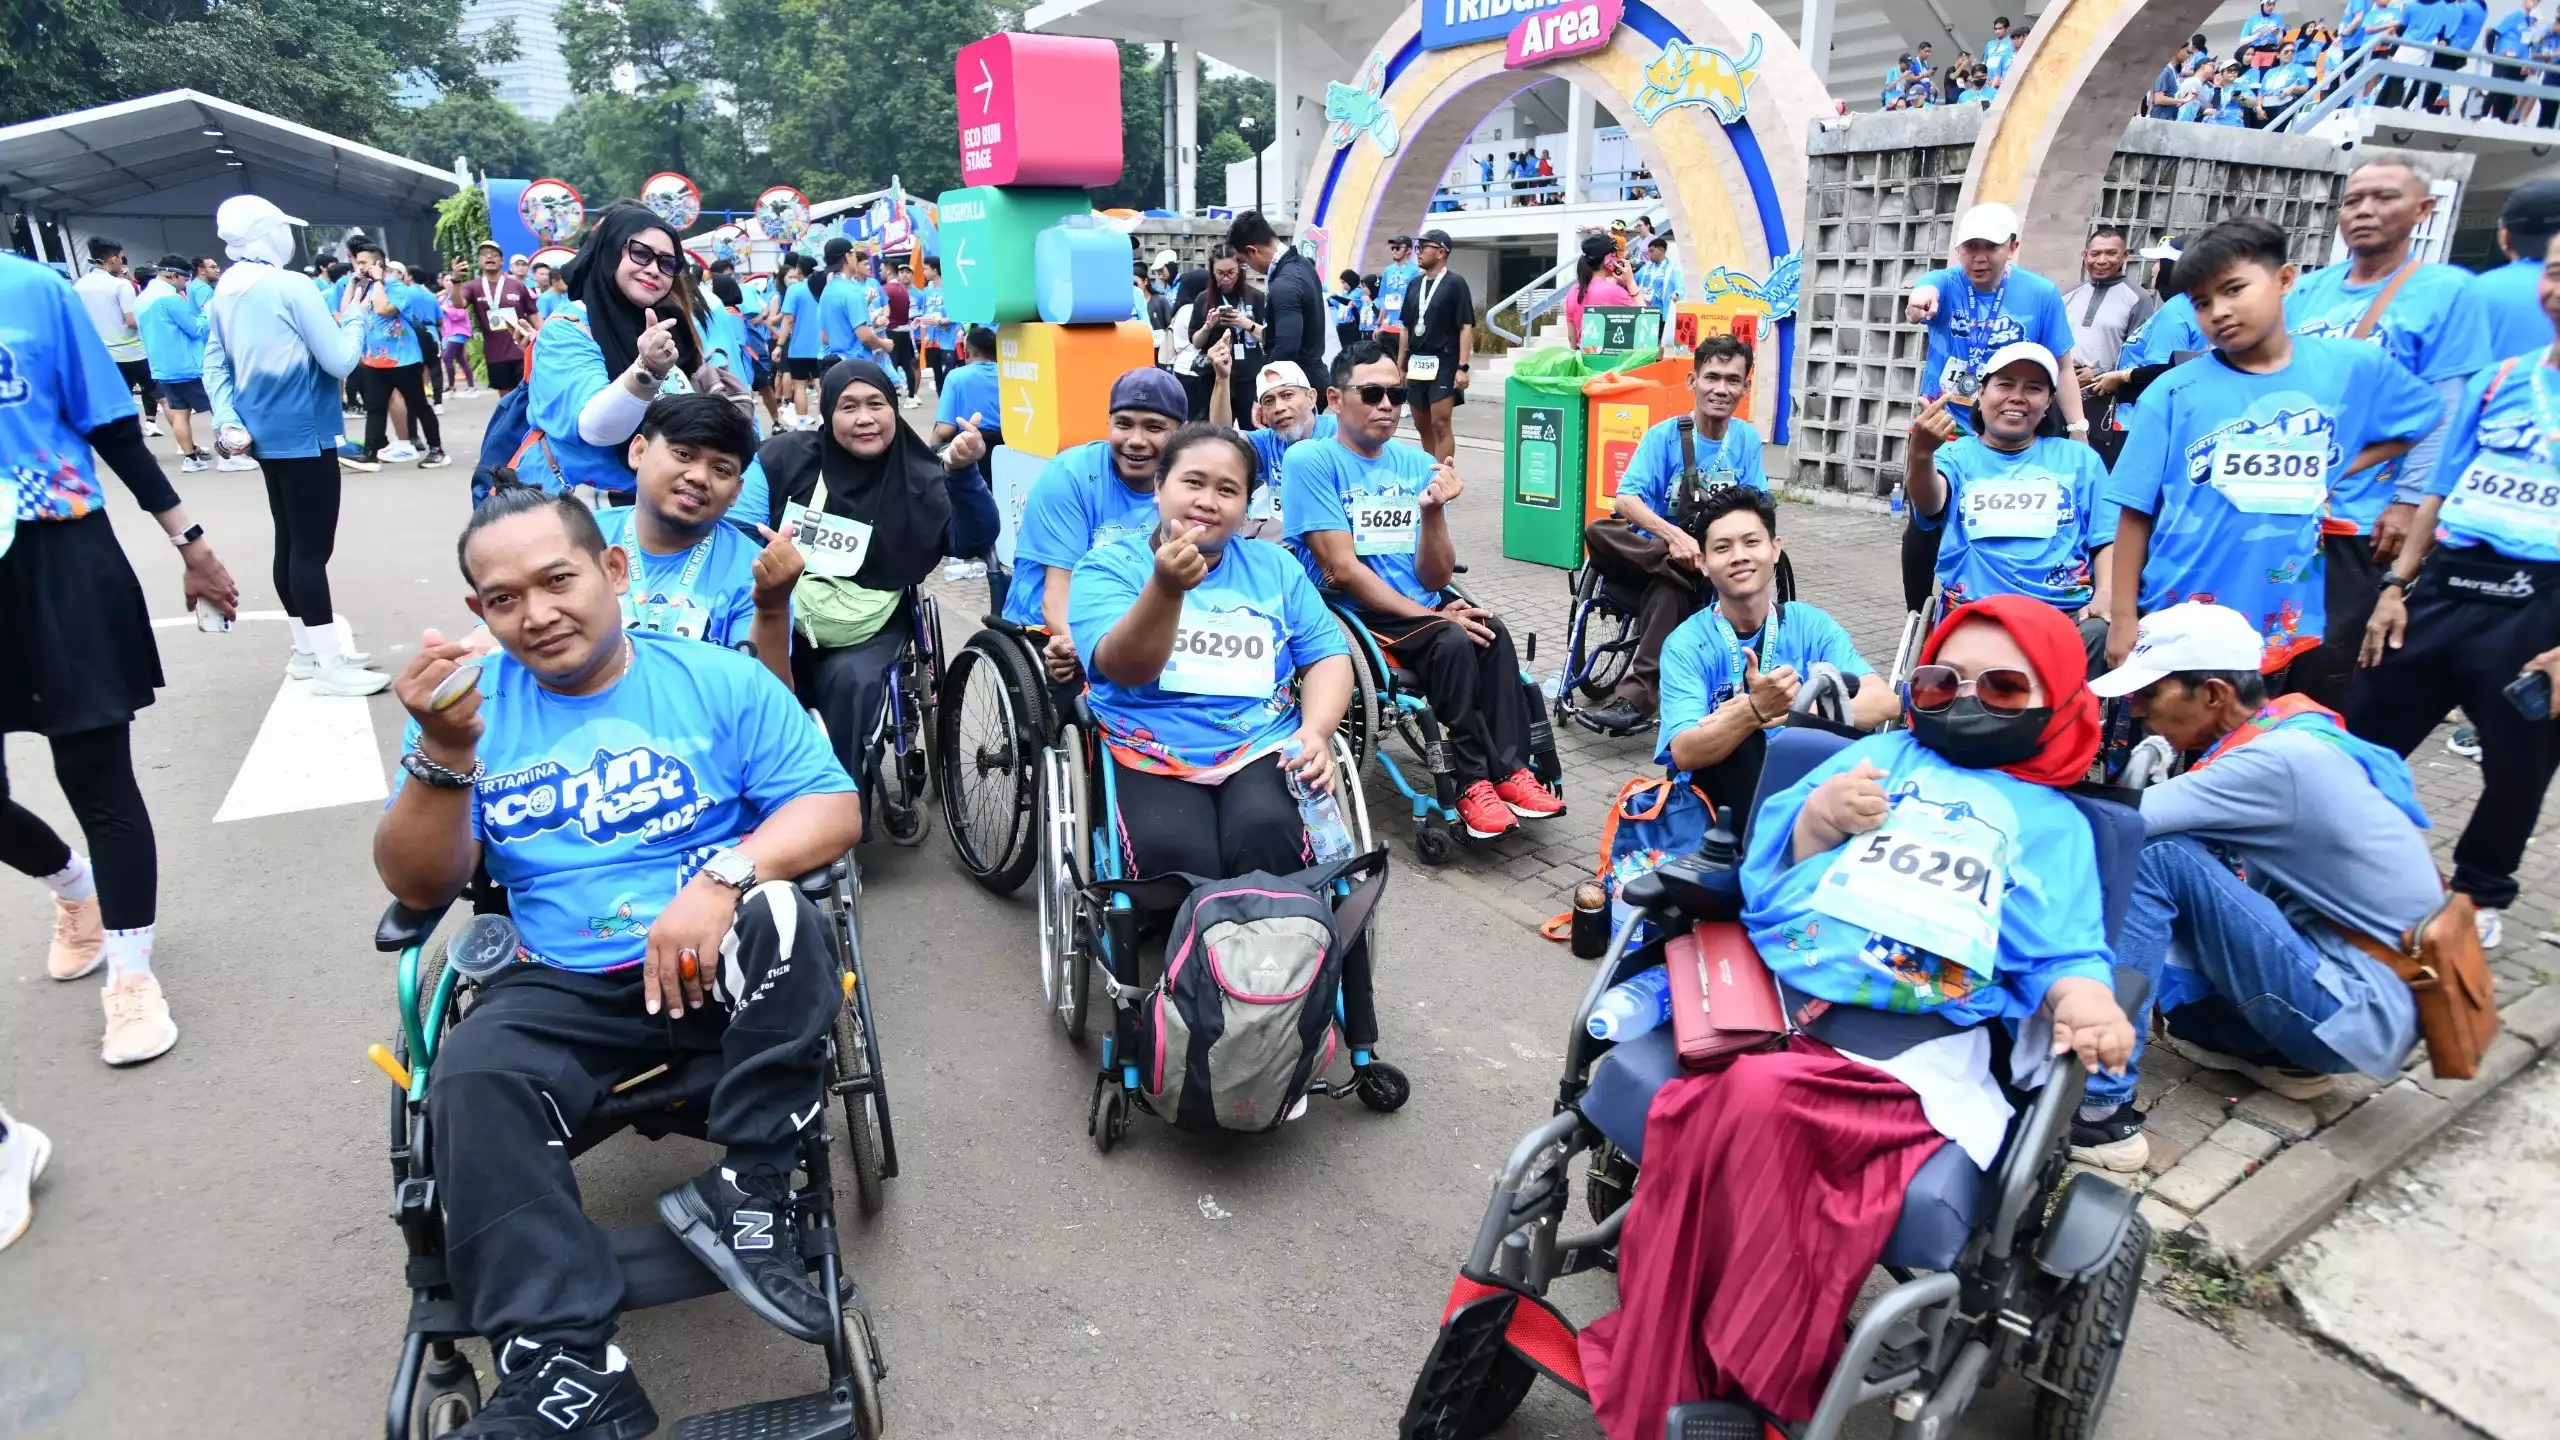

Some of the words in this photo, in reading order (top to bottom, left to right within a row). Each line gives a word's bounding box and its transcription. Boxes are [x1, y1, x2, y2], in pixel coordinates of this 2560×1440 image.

[1520, 4, 1601, 57] Area
[963, 127, 982, 149] ECO
[982, 122, 1002, 146] RUN
[965, 147, 993, 172] STAGE
[1001, 339, 1018, 358] ECO
[1002, 359, 1039, 382] MARKET
[1413, 361, 1436, 370] 23258
[2223, 453, 2321, 478] 56308
[2465, 470, 2560, 508] 56288
[1973, 492, 2048, 512] 56297
[1360, 509, 1413, 528] 56284
[791, 519, 859, 553] 5289
[690, 543, 706, 563] FUN
[629, 557, 642, 581] RUN
[680, 563, 698, 586] RUN
[1173, 628, 1264, 660] 56290
[1767, 623, 1777, 641] RUN
[1765, 641, 1775, 660] FUN
[1731, 654, 1741, 673] RUN
[1763, 660, 1772, 672] 5K
[478, 763, 560, 795] ERTAMINA
[579, 765, 685, 834] fest
[733, 1209, 774, 1250] N
[536, 1377, 599, 1430] N
